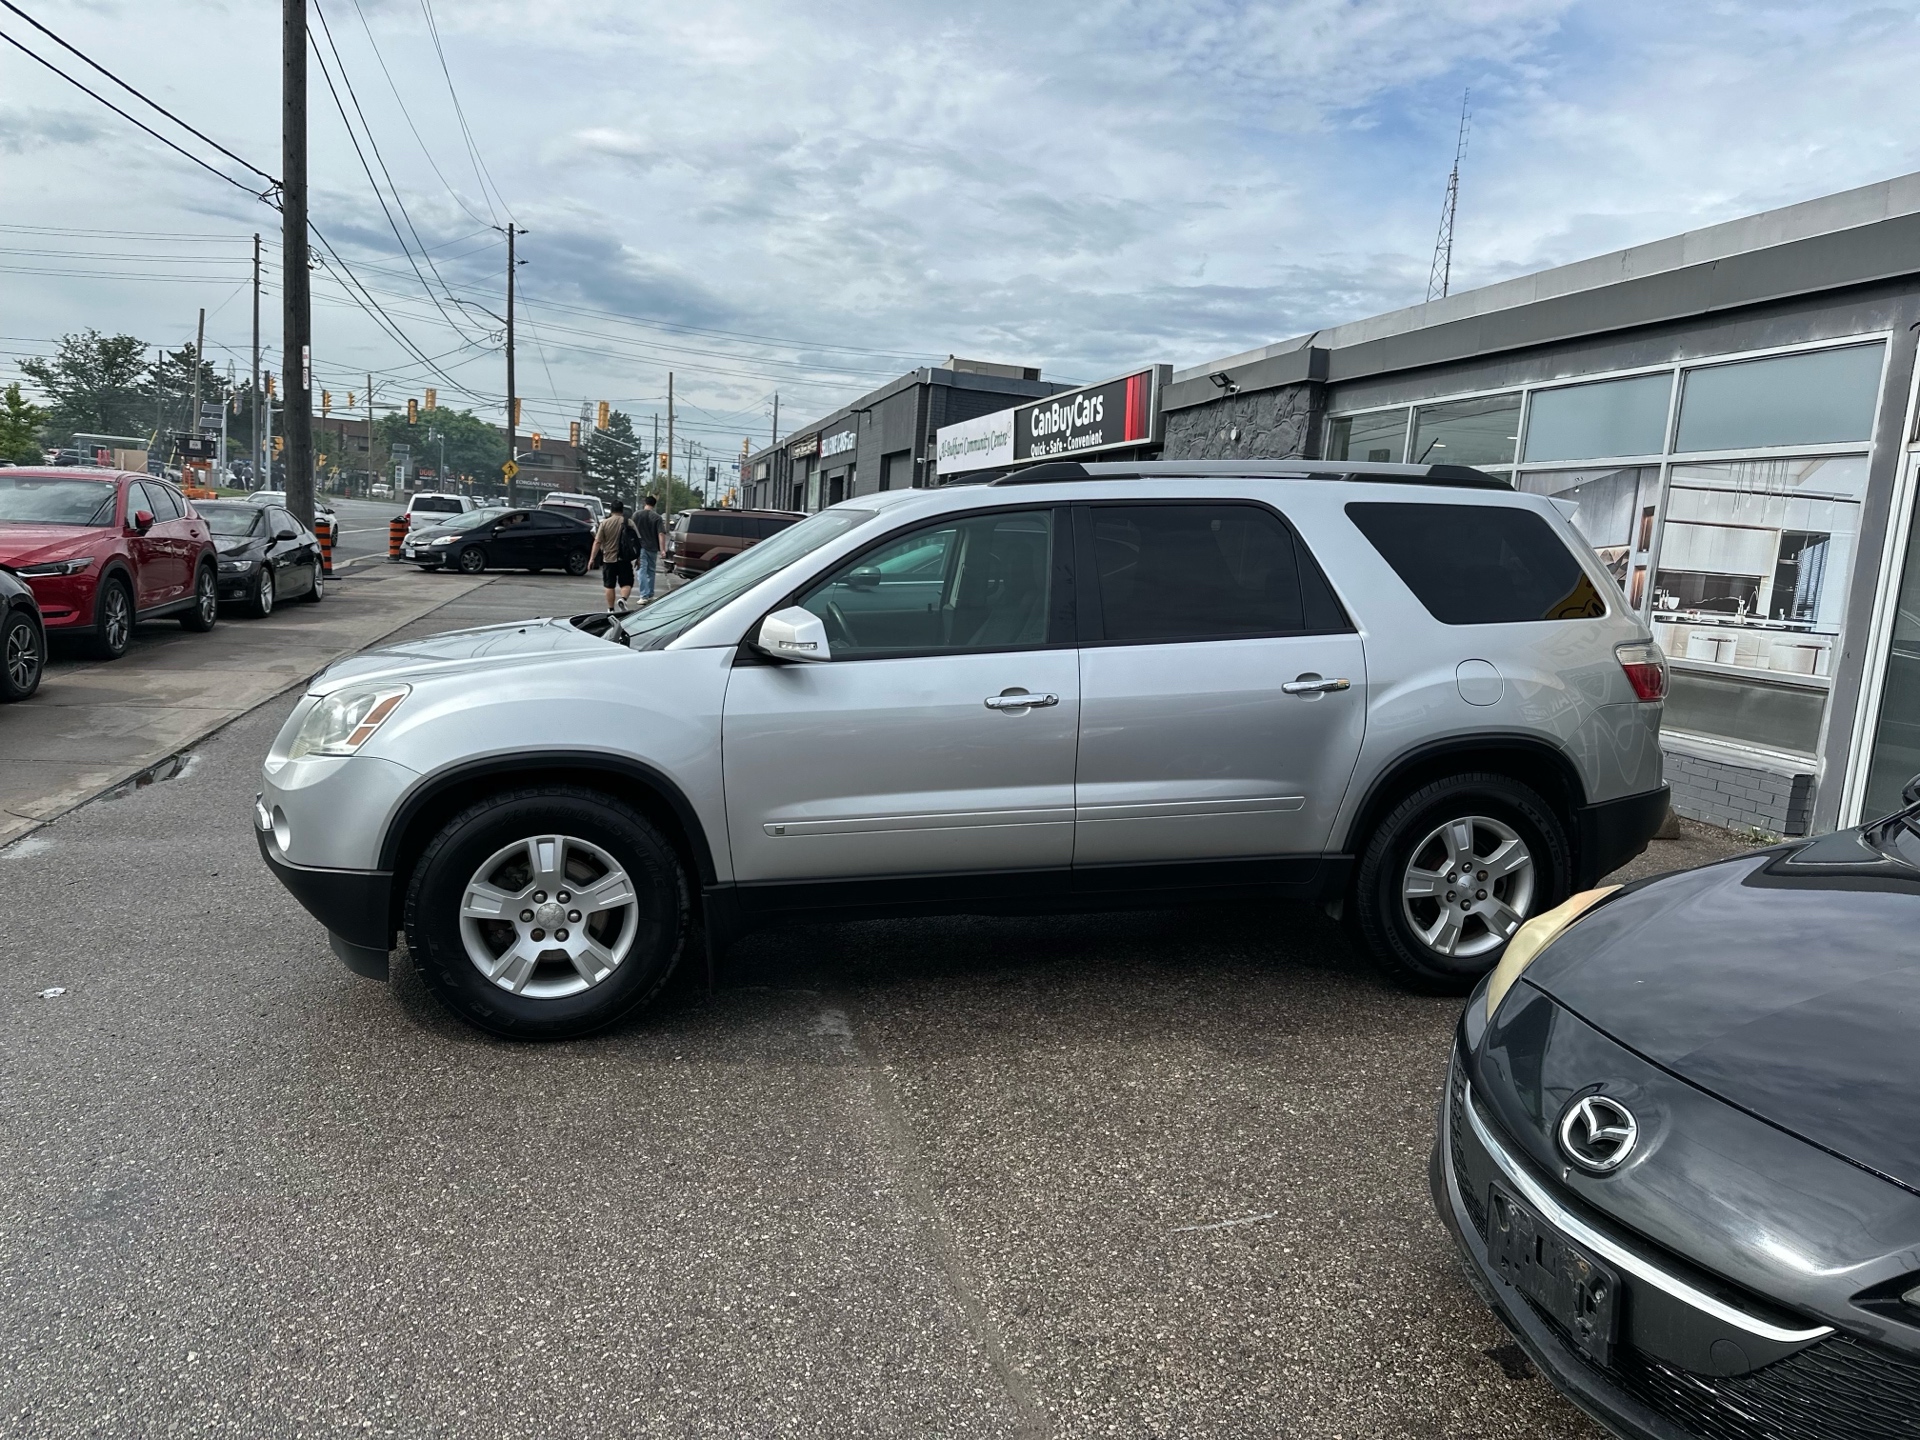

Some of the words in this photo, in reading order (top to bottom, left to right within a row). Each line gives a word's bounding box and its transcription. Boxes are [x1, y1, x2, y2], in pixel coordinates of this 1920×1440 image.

[1031, 394, 1104, 437] CanBuyCars
[964, 431, 990, 456] Community
[1030, 440, 1046, 458] Quick
[1049, 437, 1063, 454] Safe
[1067, 429, 1103, 451] Convenient
[1518, 801, 1544, 827] LTX
